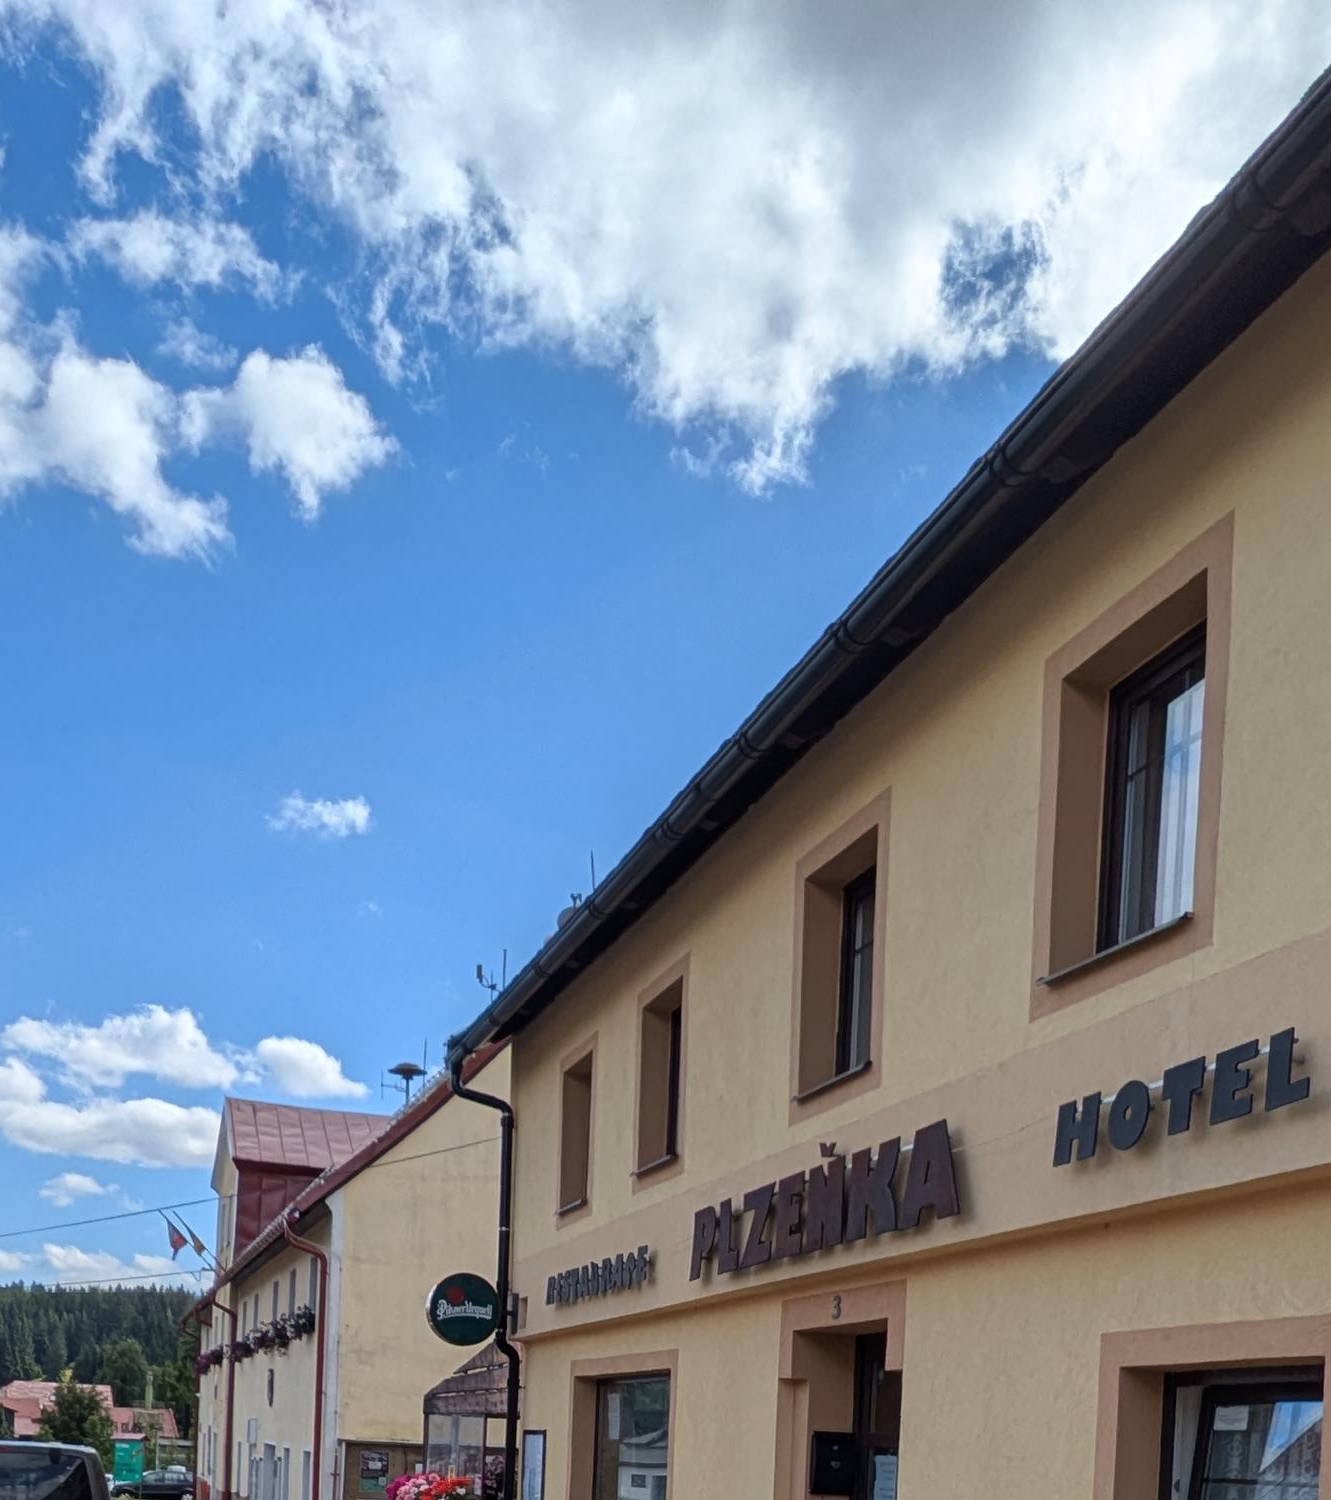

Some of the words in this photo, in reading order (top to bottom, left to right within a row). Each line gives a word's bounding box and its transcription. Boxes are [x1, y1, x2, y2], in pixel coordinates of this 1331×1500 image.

[1052, 1027, 1311, 1166] HOTEL
[689, 1118, 960, 1282] PLZEŇKA
[831, 1295, 842, 1320] 3
